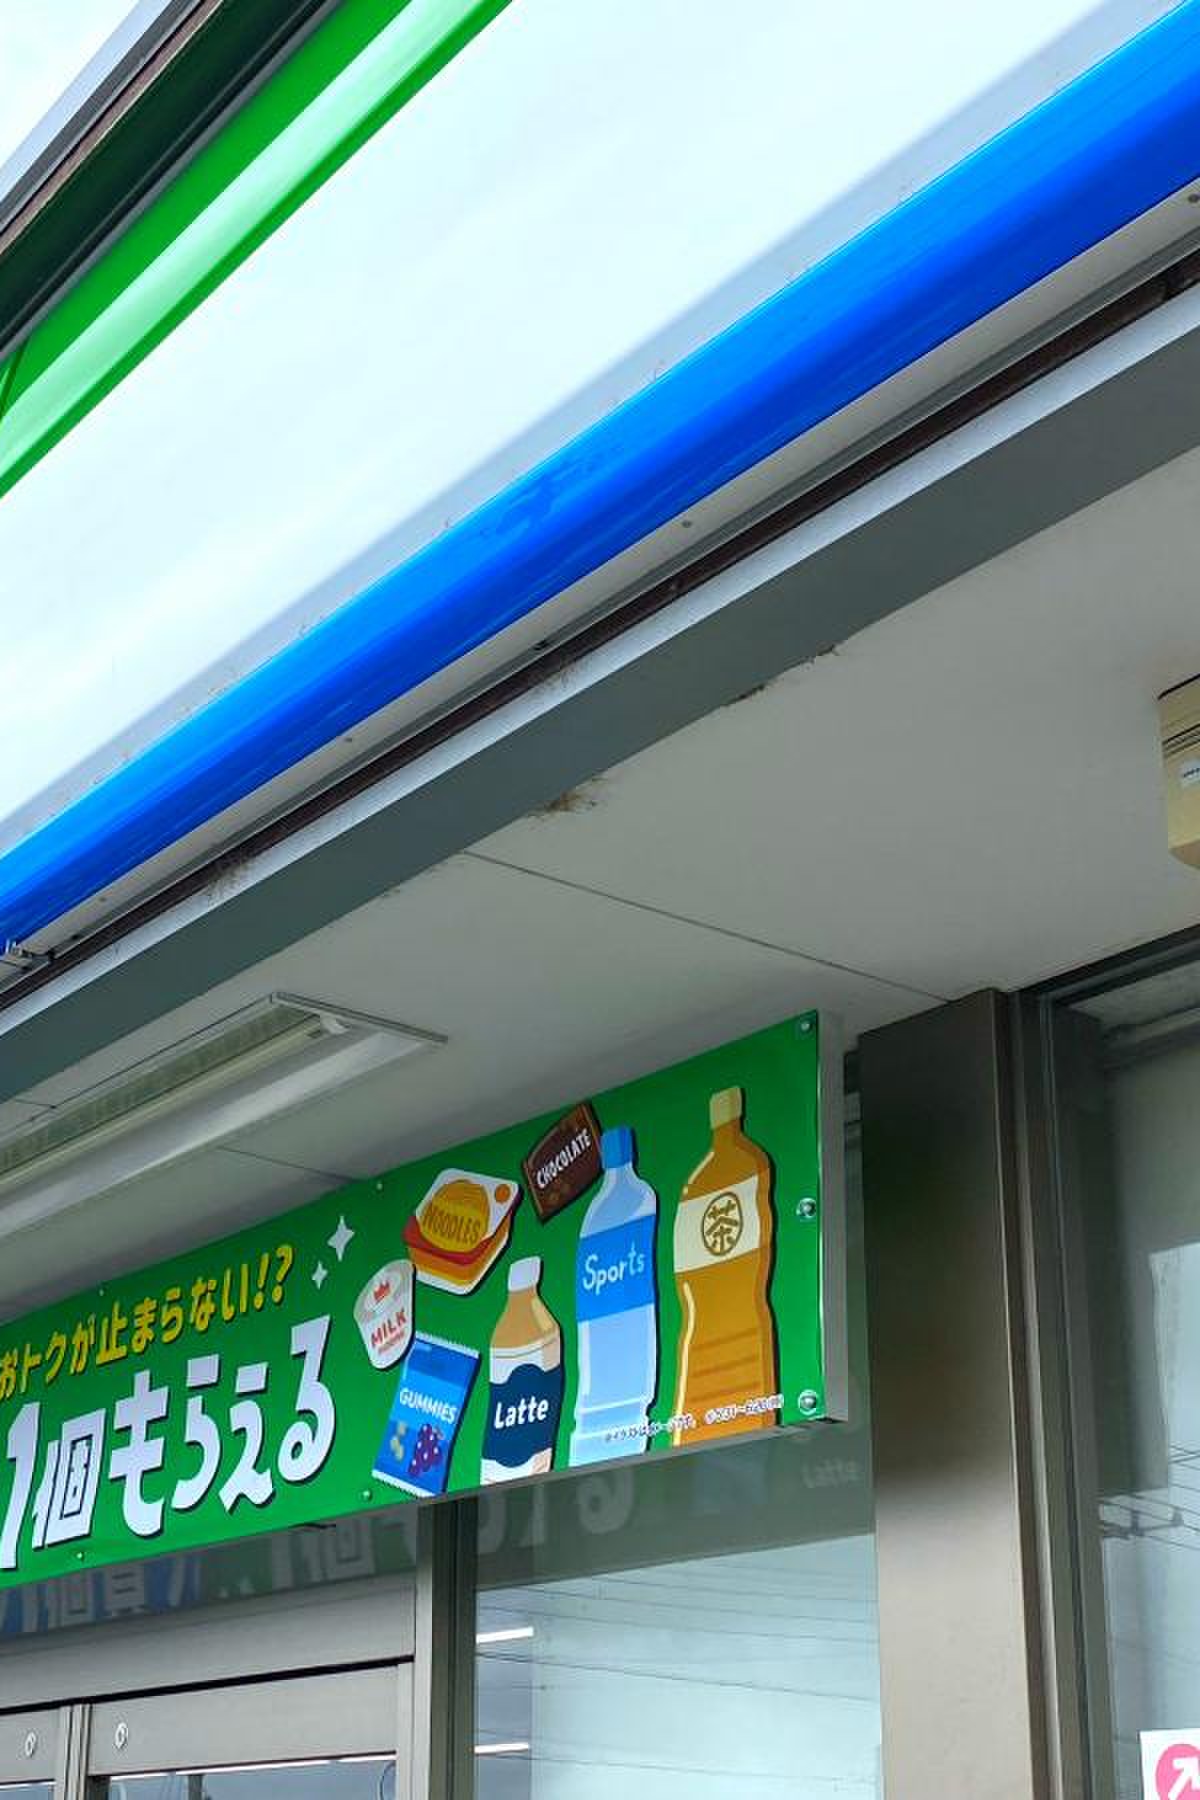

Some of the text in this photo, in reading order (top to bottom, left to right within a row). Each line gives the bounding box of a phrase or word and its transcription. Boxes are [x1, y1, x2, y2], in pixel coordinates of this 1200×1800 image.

[536, 1127, 592, 1189] CHOCOLATE
[422, 1204, 482, 1245] NOODLES
[705, 1199, 739, 1252] 茶
[582, 1239, 646, 1296] Sports
[371, 1307, 408, 1350] MILK
[399, 1387, 458, 1425] GUMMIES
[493, 1395, 550, 1430] Latte
